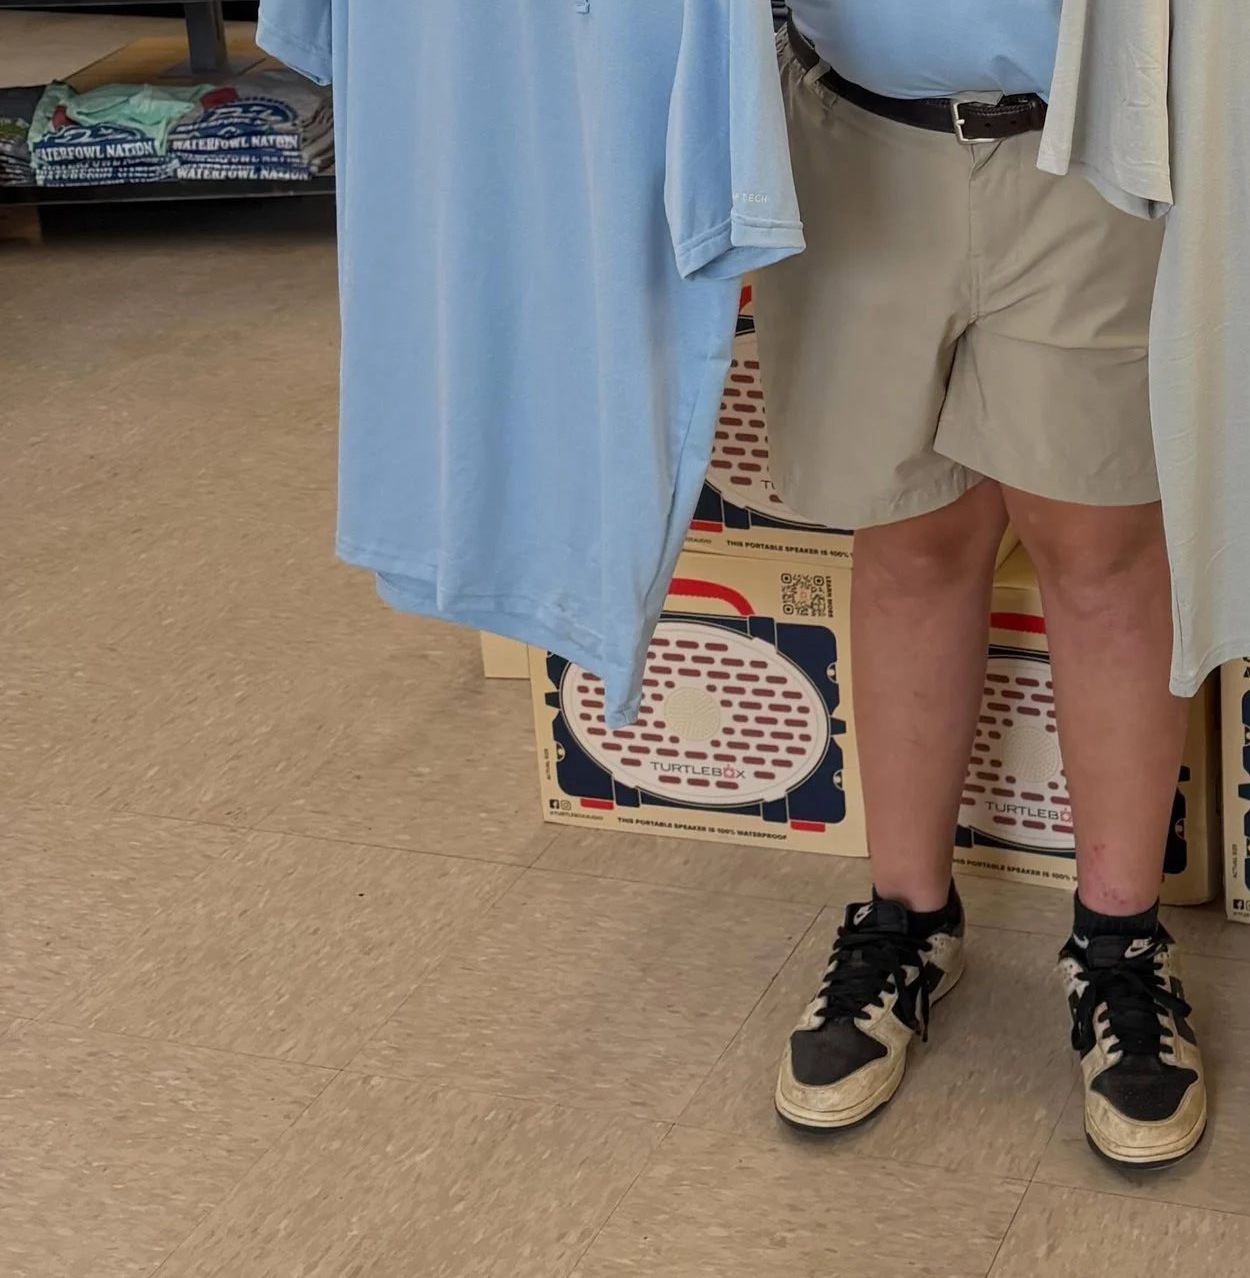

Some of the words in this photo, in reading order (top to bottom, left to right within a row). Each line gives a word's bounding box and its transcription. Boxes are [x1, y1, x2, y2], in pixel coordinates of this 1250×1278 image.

[172, 136, 249, 151] WATERFOWL
[744, 542, 784, 552] PORTABLE
[785, 546, 819, 555] SPEAKER
[829, 550, 850, 558] 100%
[650, 762, 746, 780] TURTLEBOX
[636, 818, 672, 828] PORTABLE
[674, 822, 706, 832] SPEAKER
[736, 829, 788, 840] WATERPROOF
[966, 860, 1006, 871] PORTABLE
[1006, 866, 1041, 876] SPEAKER
